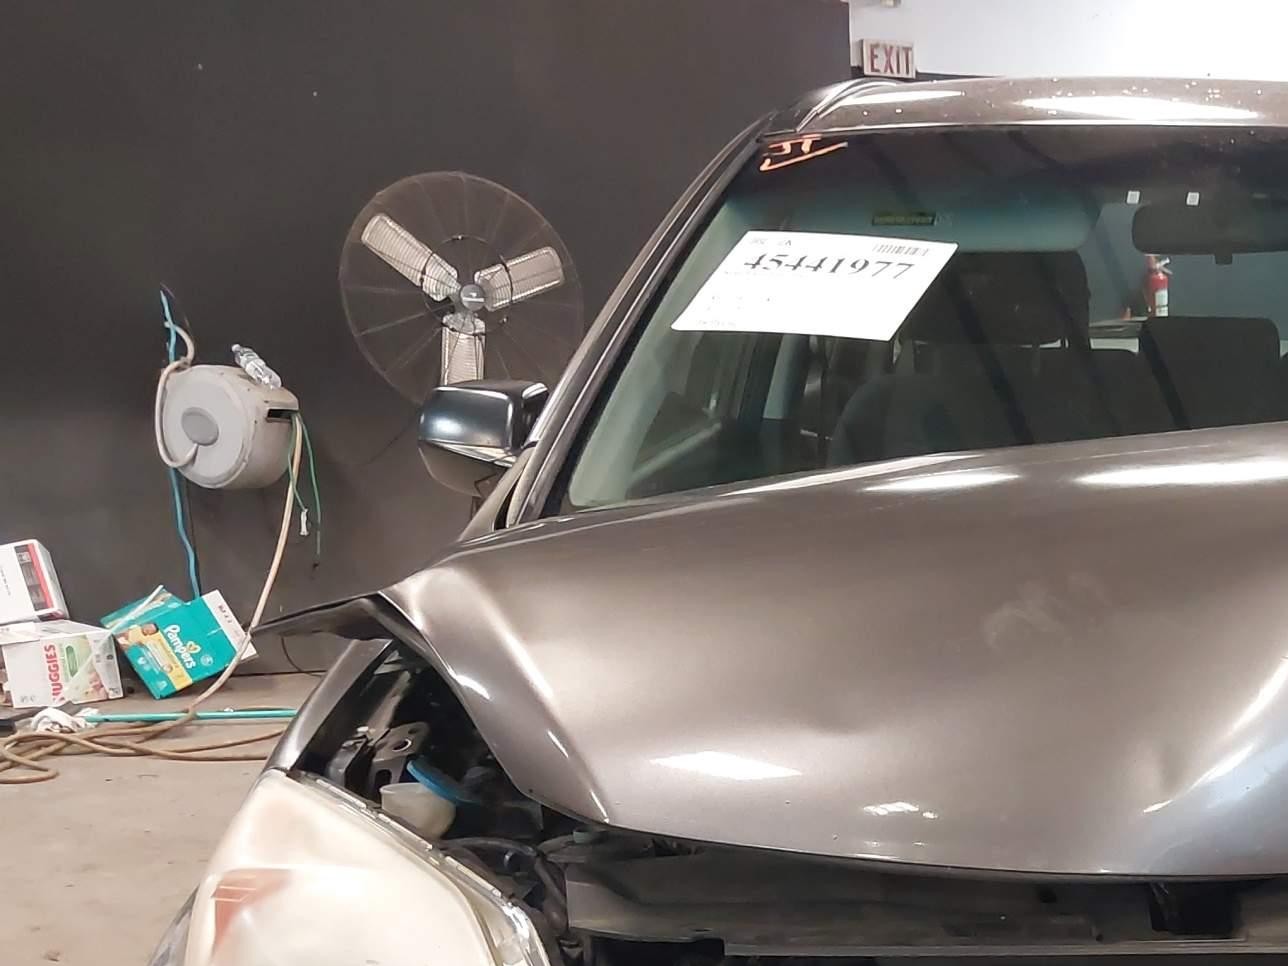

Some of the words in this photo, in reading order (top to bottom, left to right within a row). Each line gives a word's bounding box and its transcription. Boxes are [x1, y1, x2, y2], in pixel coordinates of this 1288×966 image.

[870, 43, 912, 75] EXIT
[744, 253, 915, 279] 45441977
[163, 624, 196, 669] Pampers
